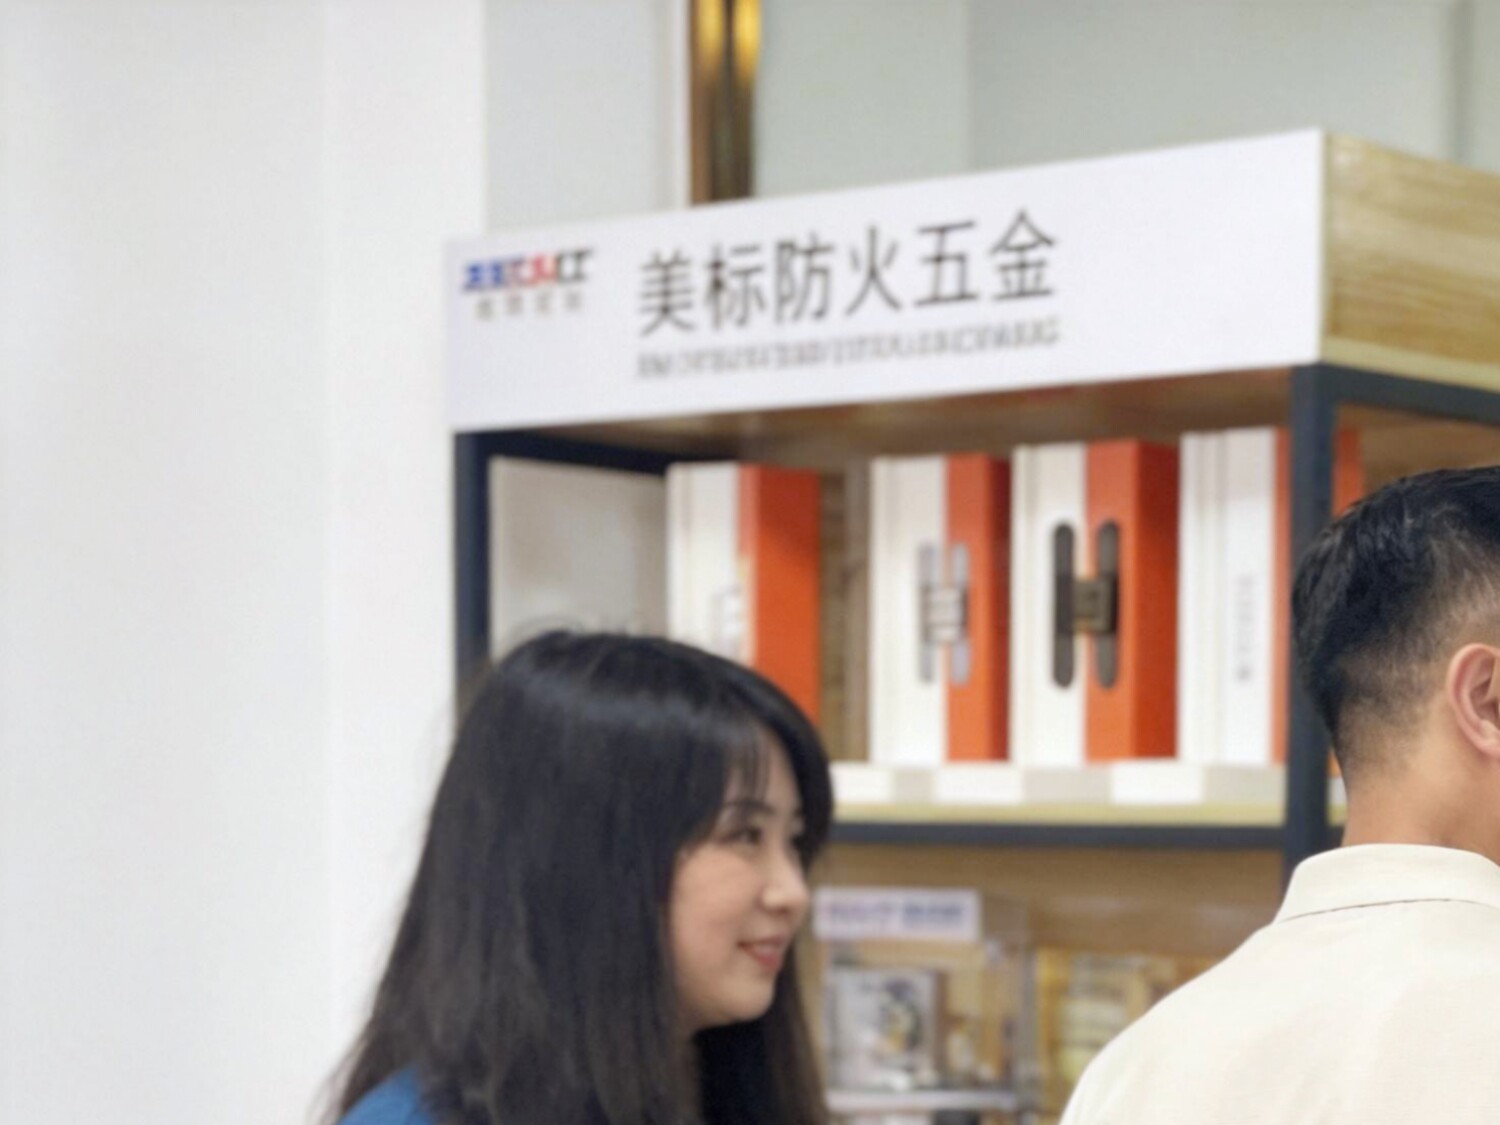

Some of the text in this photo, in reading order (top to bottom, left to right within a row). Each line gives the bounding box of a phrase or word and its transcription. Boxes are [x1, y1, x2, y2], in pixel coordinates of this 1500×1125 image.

[638, 207, 1056, 337] 美标防火五金
